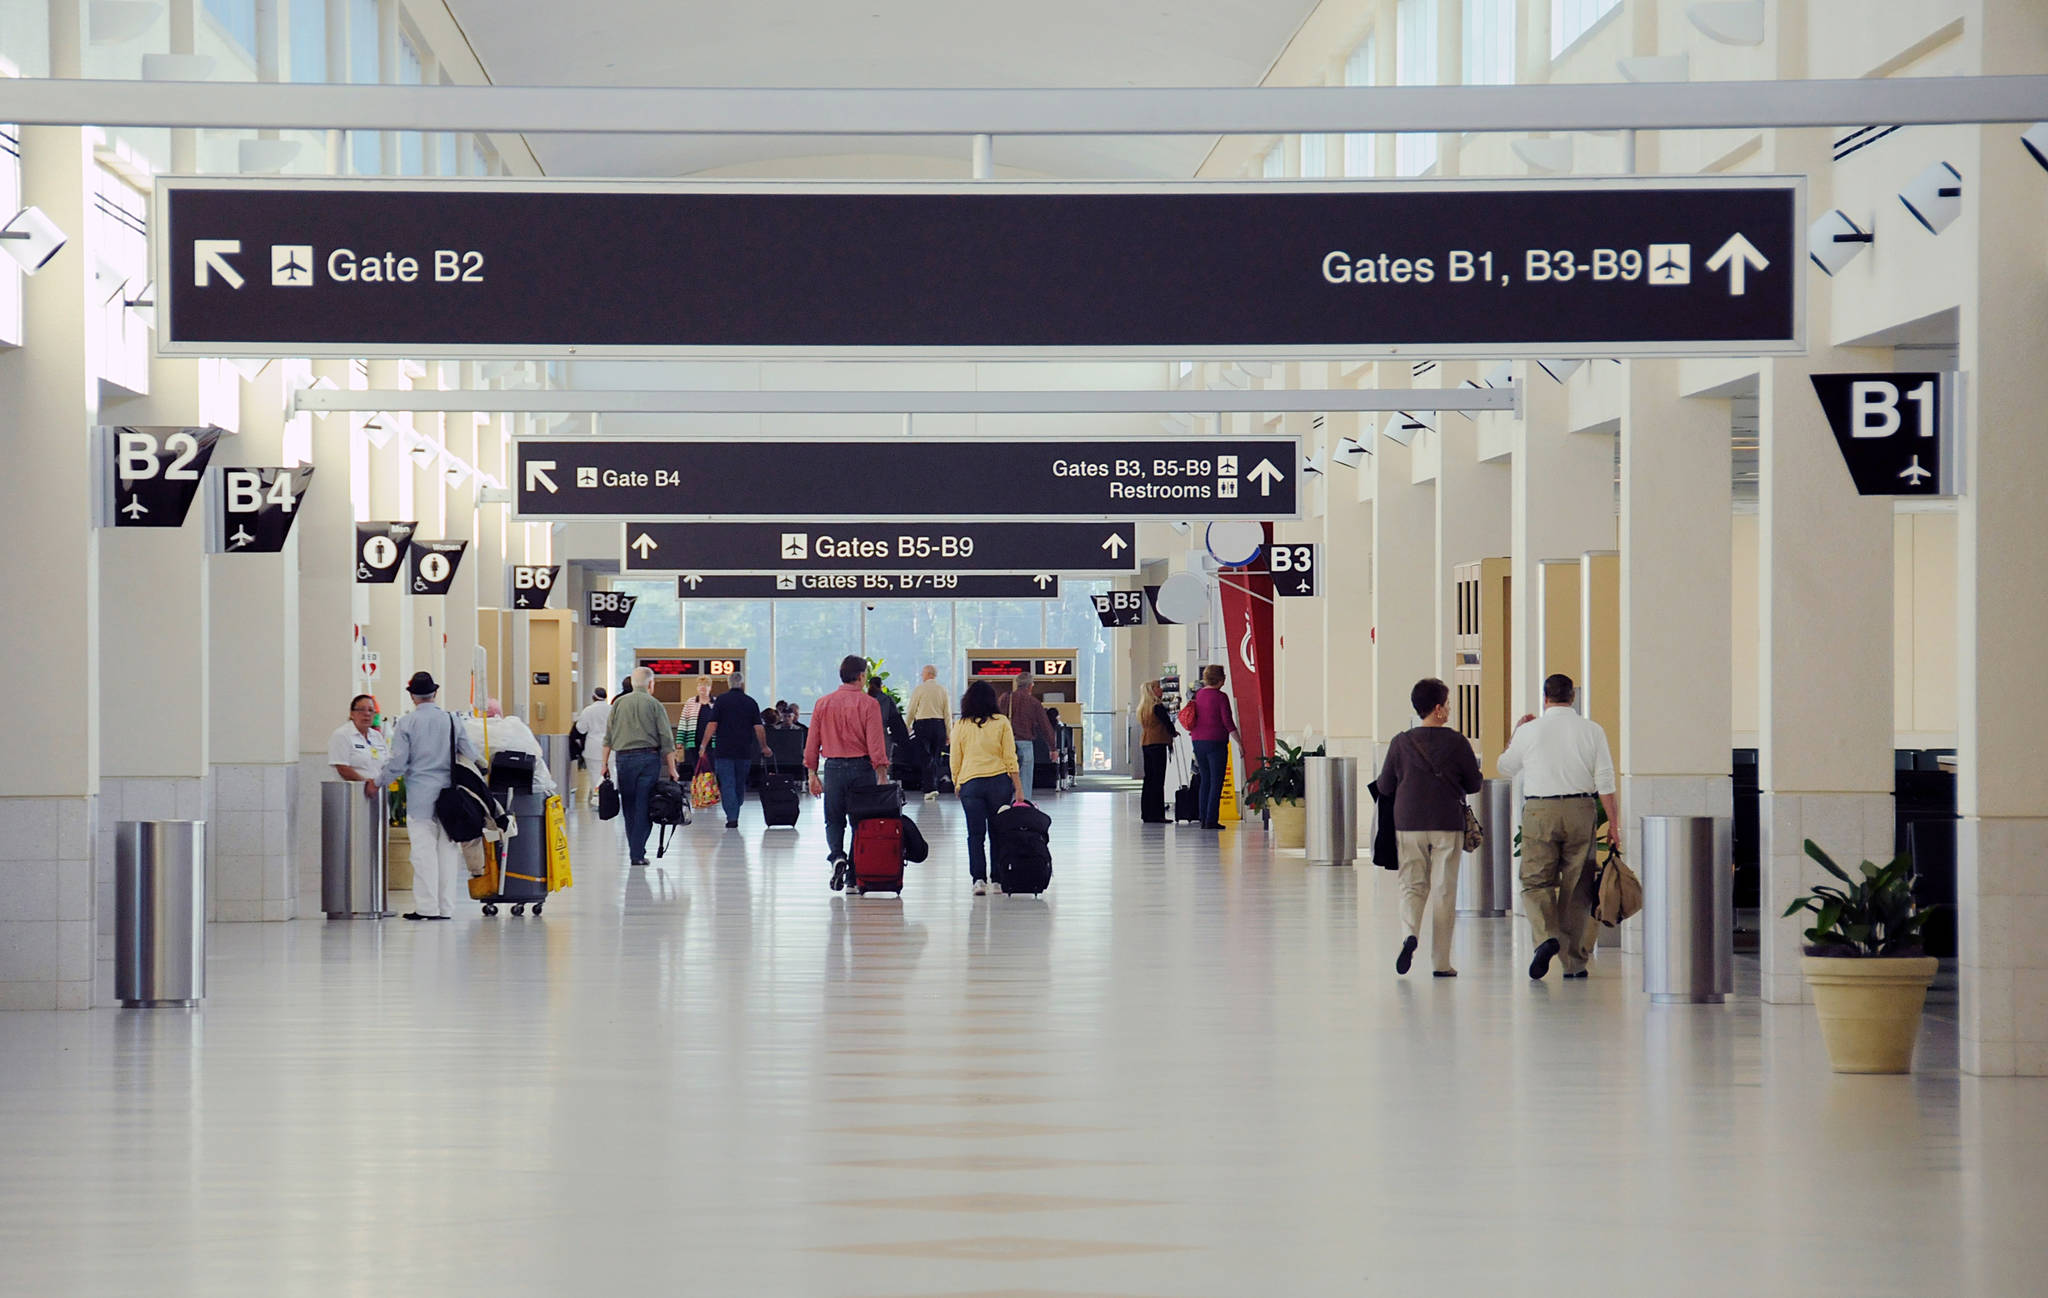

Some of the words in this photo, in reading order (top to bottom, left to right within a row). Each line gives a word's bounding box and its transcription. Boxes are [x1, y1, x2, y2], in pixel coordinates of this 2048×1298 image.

[327, 248, 419, 283] Gate
[434, 250, 484, 282] B2
[1322, 250, 1434, 284] Gates
[1449, 250, 1509, 287] B1,
[1526, 248, 1642, 282] B3-B9
[1852, 380, 1934, 438] B1
[119, 432, 199, 480] B2
[1052, 459, 1109, 477] Gates
[1115, 459, 1146, 479] B3,
[1153, 459, 1211, 476] B5-B9
[602, 470, 649, 488] Gate
[655, 470, 681, 487] B4
[227, 471, 296, 513] B4
[1110, 482, 1211, 499] Restrooms
[391, 525, 411, 534] Men
[432, 543, 461, 552] Women
[815, 536, 889, 558] Gates
[898, 535, 974, 557] B5-B9
[1270, 546, 1312, 573] B3
[515, 566, 551, 590] B6
[801, 575, 857, 589] Gates
[863, 575, 894, 591] B5,
[900, 575, 958, 589] B7-B9
[591, 593, 619, 612] B8
[1113, 592, 1141, 610] B5
[710, 660, 735, 675] B9
[1044, 660, 1067, 675] B7
